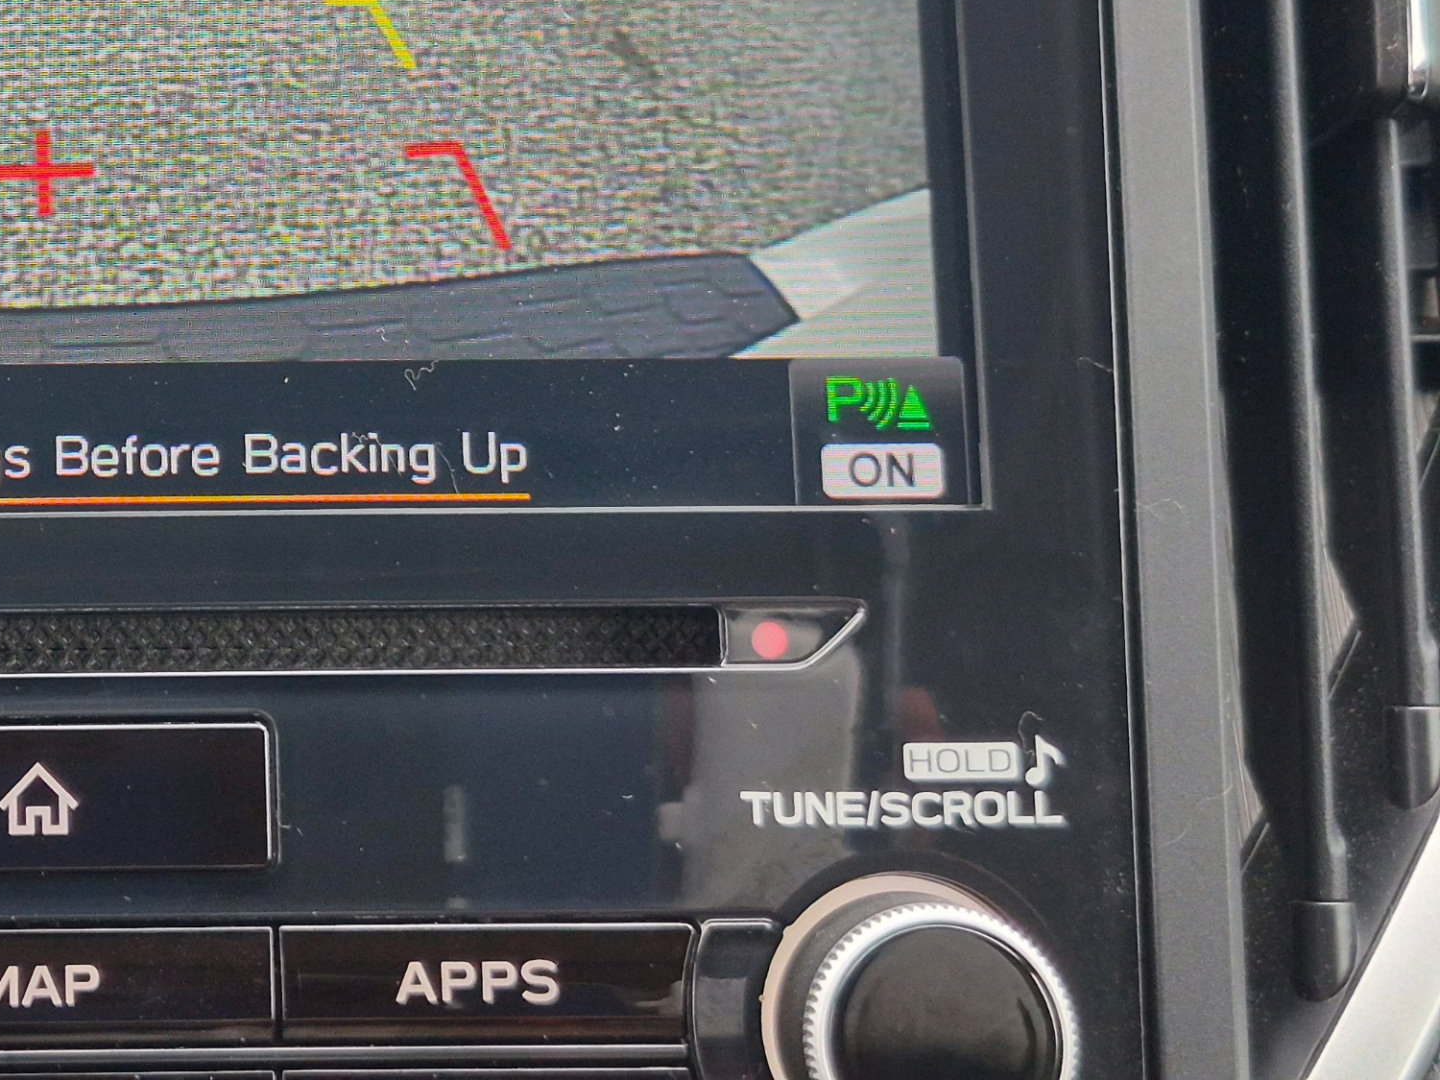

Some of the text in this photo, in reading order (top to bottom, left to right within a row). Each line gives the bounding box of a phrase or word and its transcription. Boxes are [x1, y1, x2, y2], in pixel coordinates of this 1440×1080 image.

[54, 434, 221, 479] Before
[242, 431, 437, 485] Backing
[461, 431, 529, 485] Up
[847, 452, 917, 489] ON
[908, 746, 1012, 775] HOLD
[739, 787, 1067, 829] TUNE/SCROLL
[394, 958, 561, 1006] APPS
